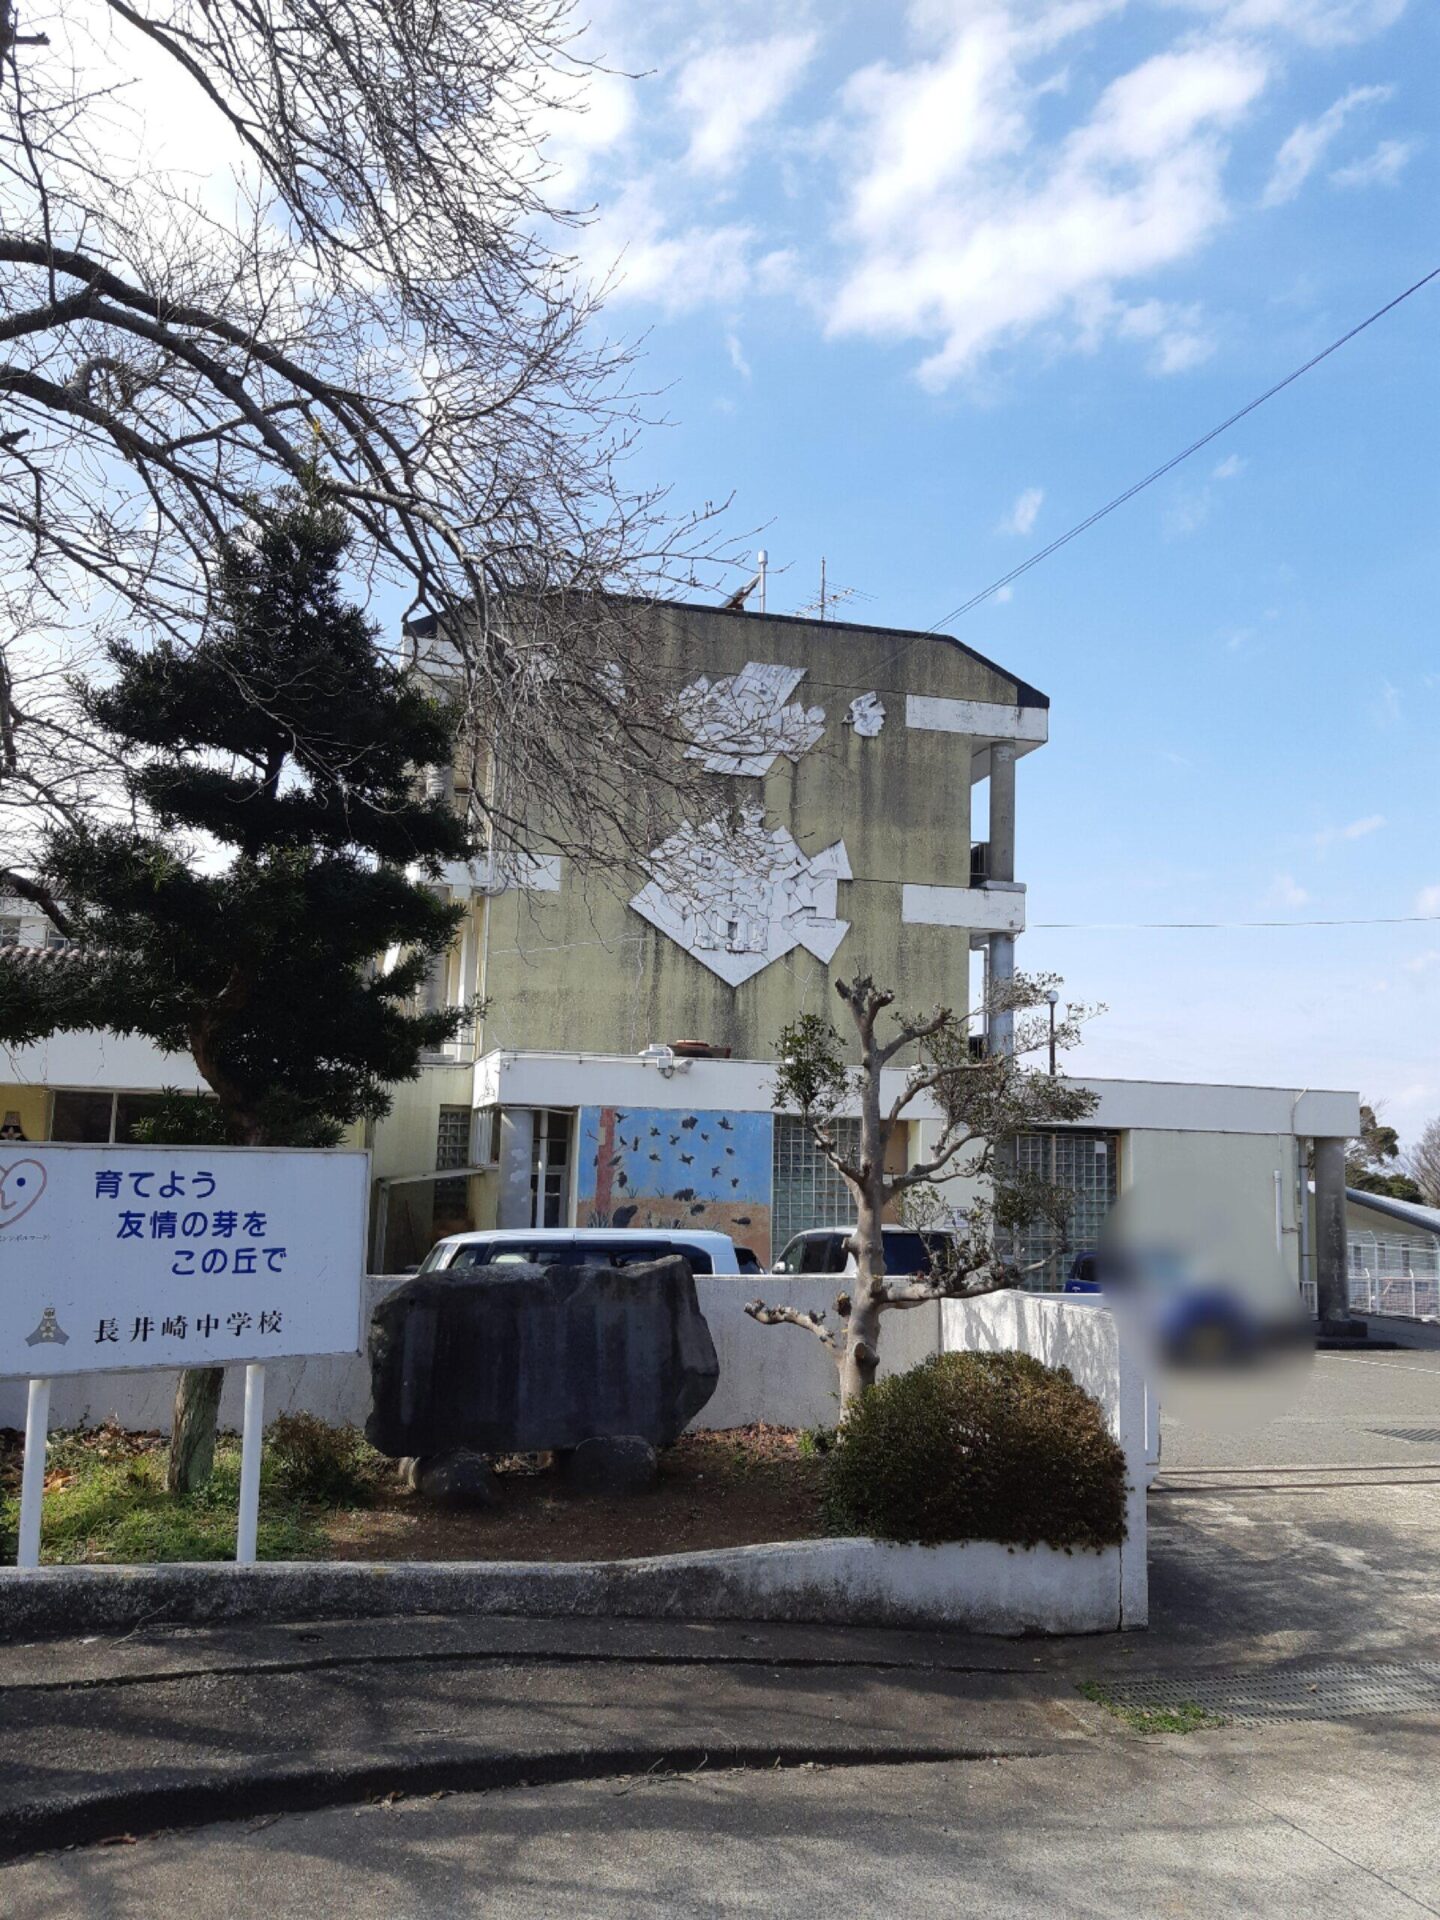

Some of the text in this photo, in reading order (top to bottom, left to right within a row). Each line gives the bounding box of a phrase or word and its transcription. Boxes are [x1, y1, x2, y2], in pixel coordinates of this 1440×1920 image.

[95, 1170, 216, 1199] 育てよう
[116, 1210, 268, 1239] 友情の芽を
[171, 1247, 287, 1275] この丘で
[94, 1310, 283, 1344] 長井崎中学校
